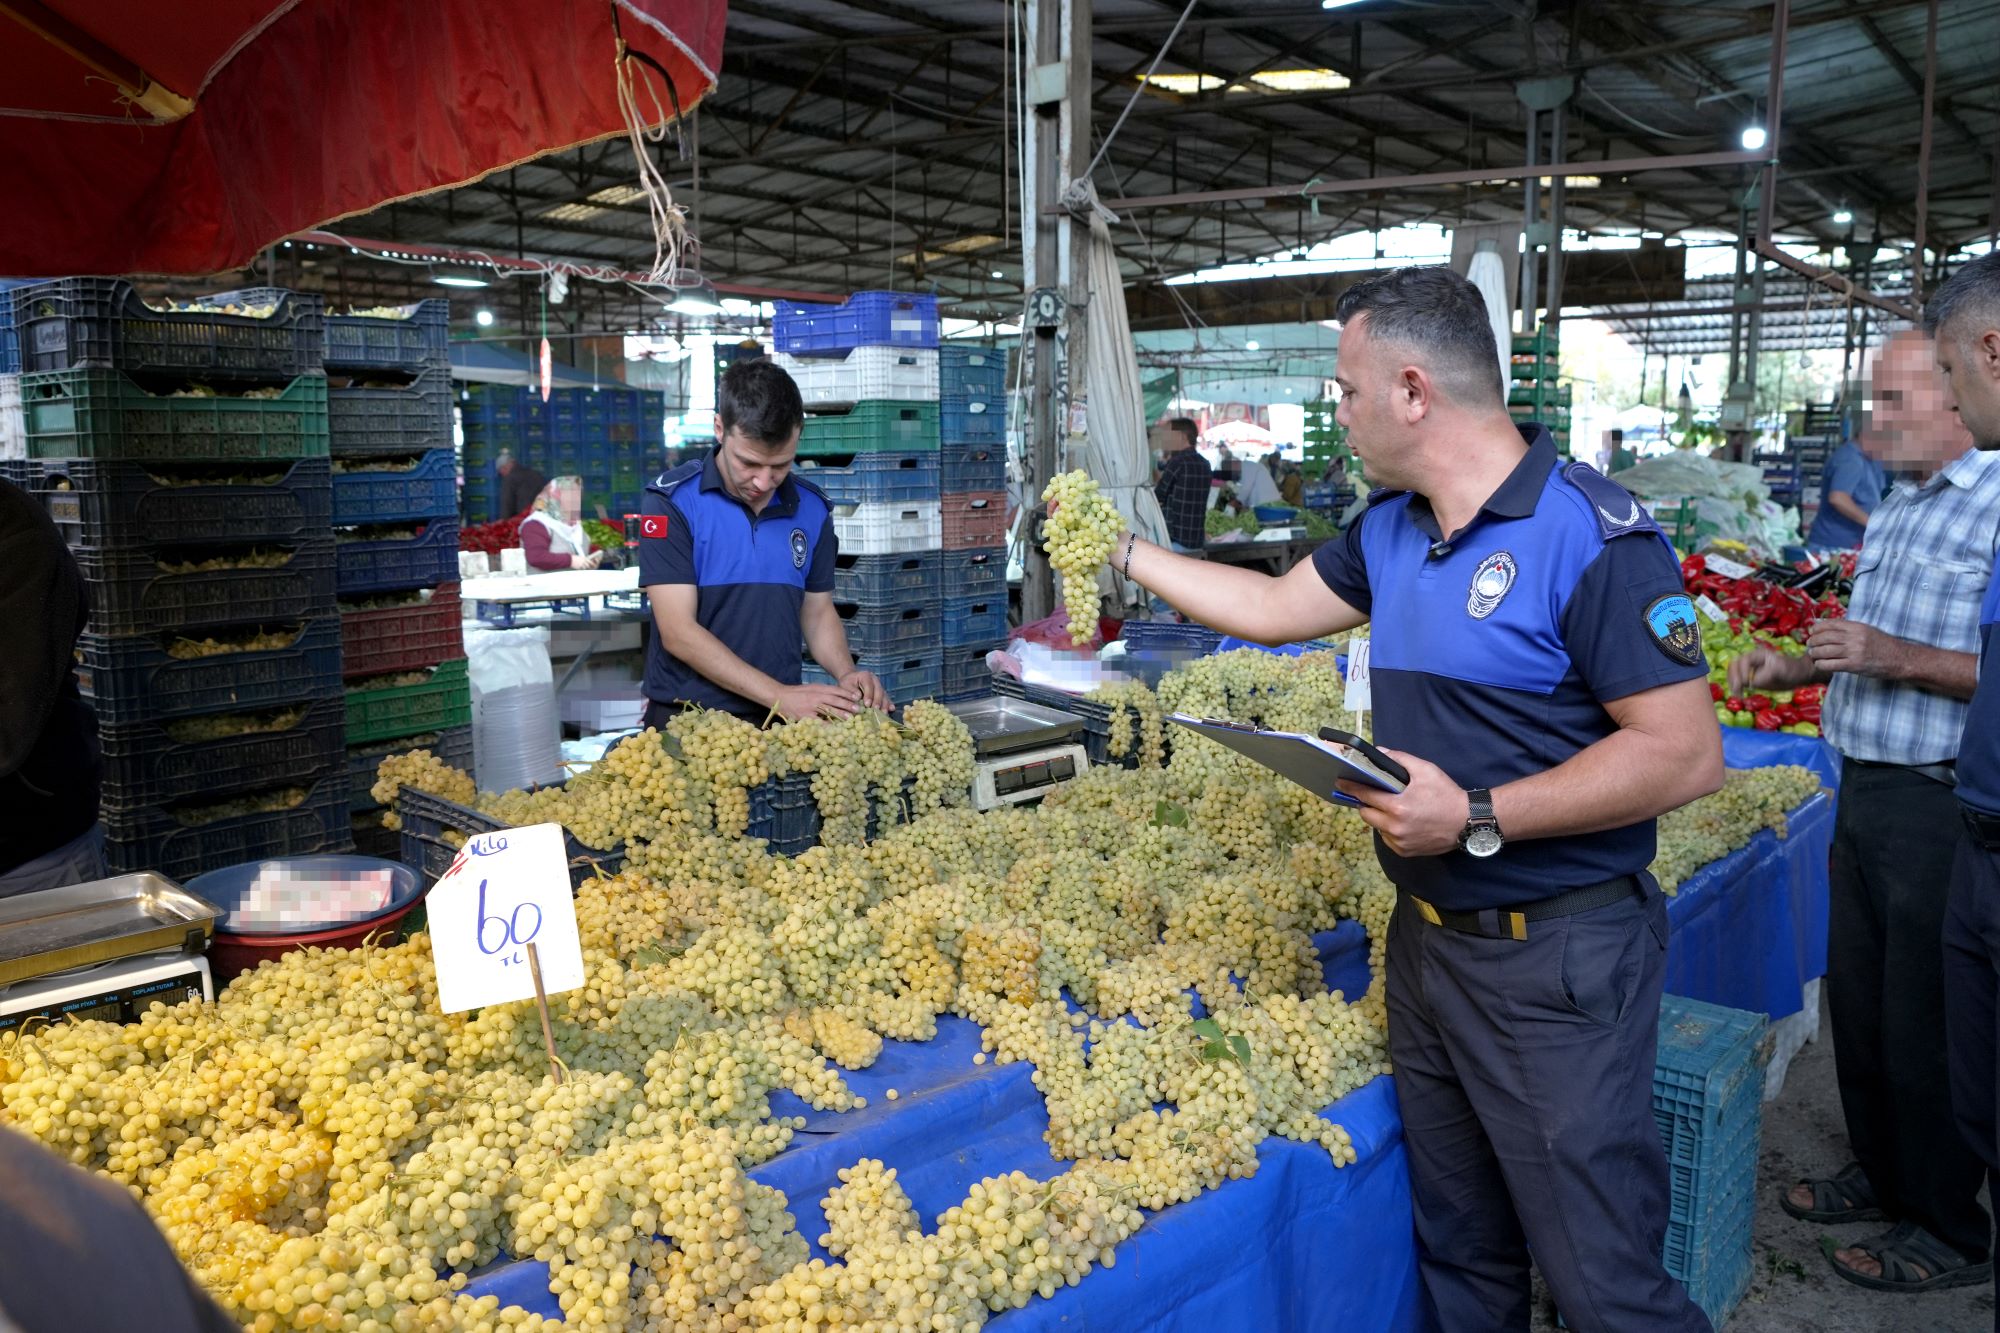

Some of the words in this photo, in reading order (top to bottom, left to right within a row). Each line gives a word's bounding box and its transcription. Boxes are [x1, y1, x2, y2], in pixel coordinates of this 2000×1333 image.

[477, 879, 542, 954] 60
[132, 985, 156, 996] TOPLAM
[155, 981, 175, 991] TUTAR
[80, 999, 97, 1008] FİYAT
